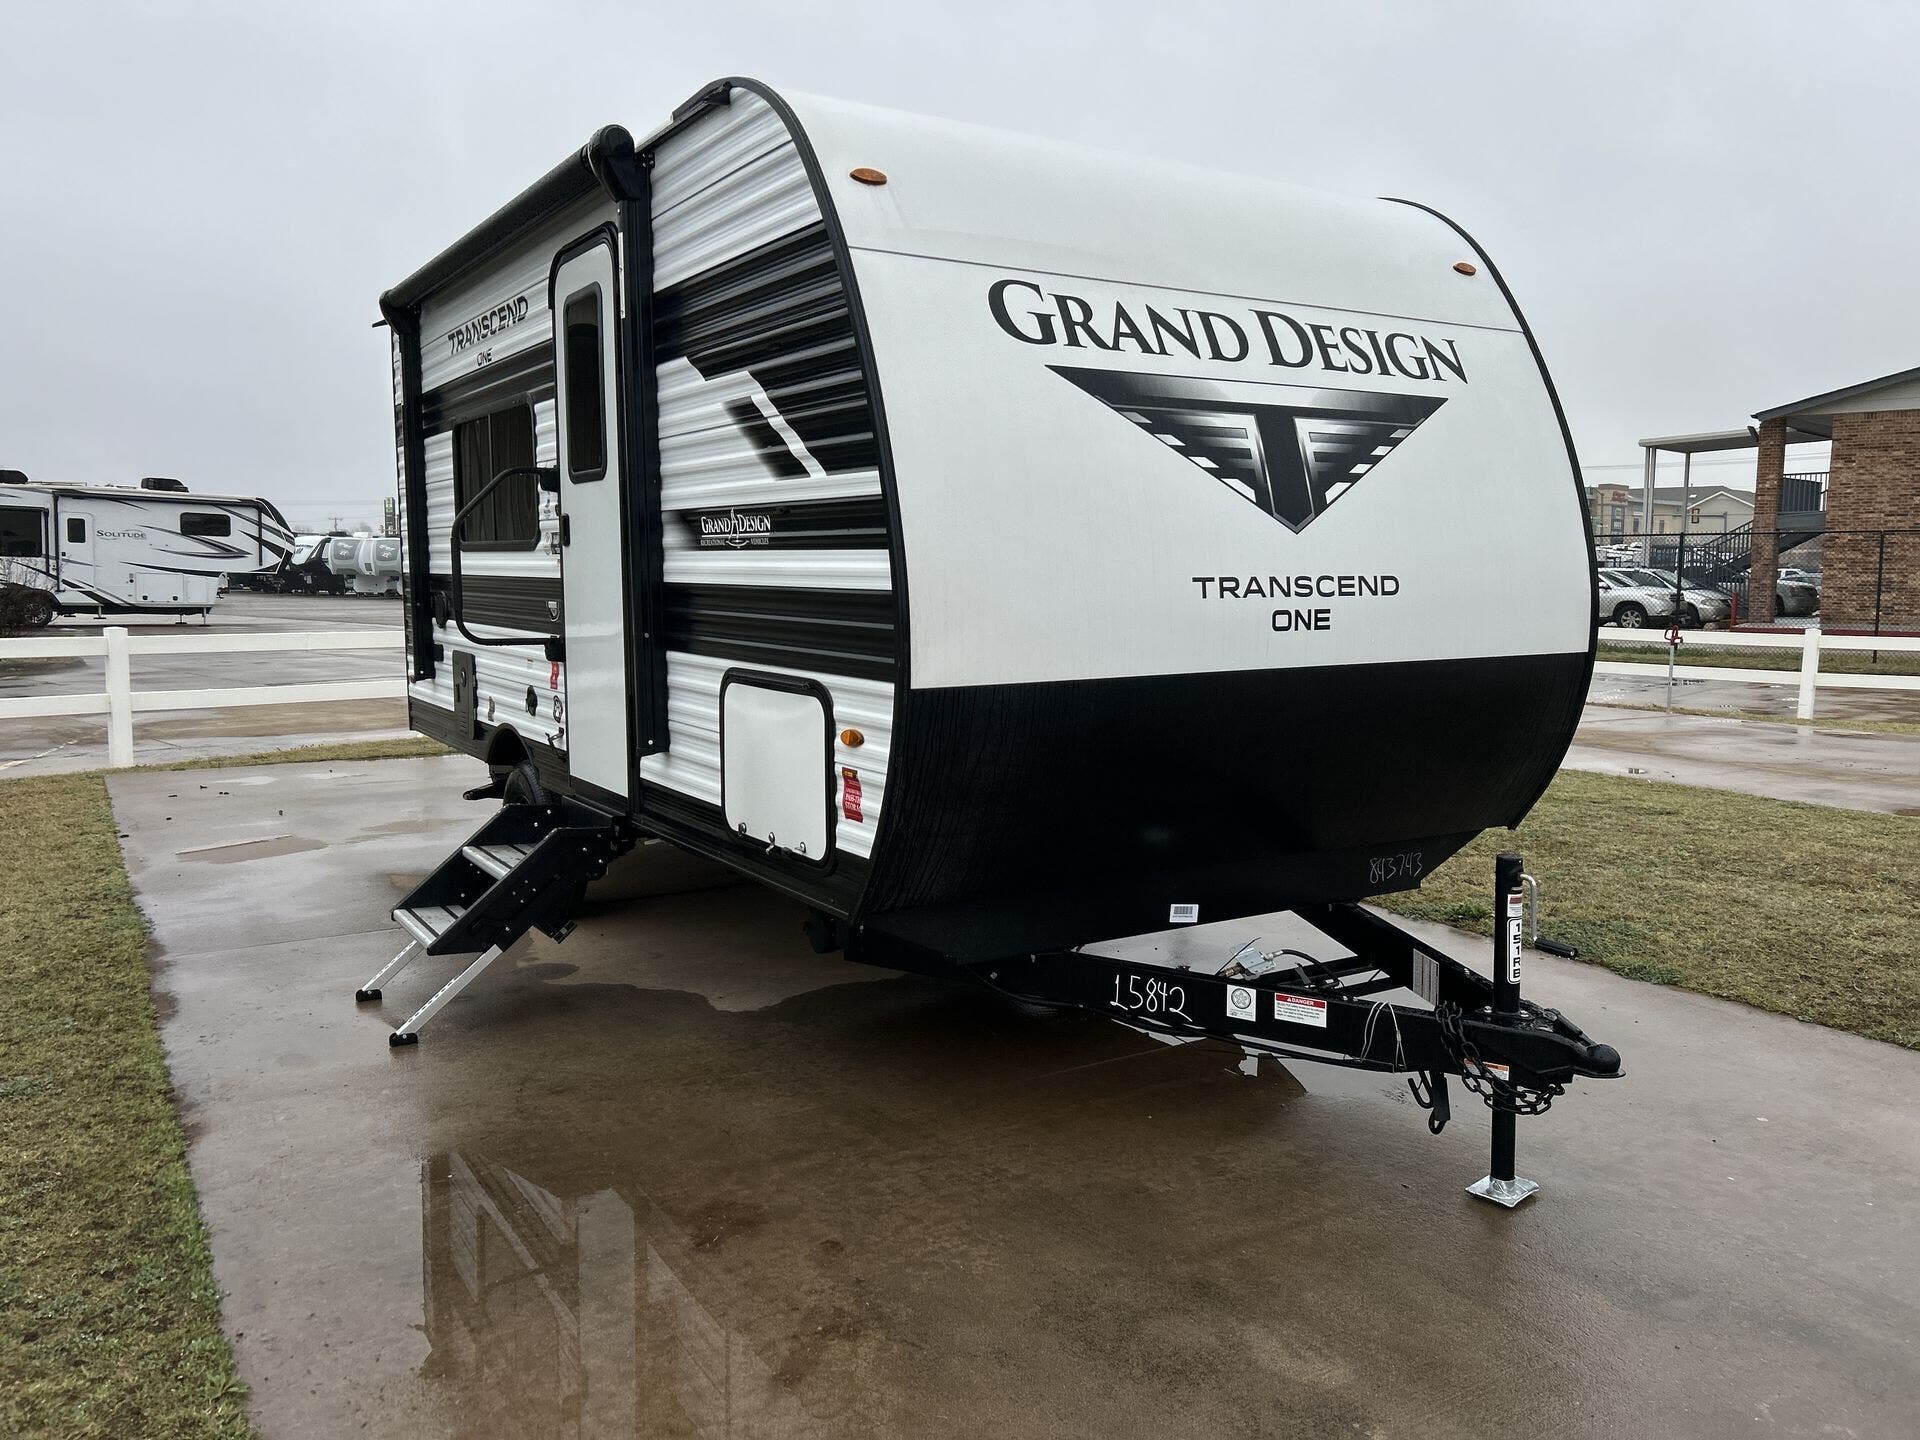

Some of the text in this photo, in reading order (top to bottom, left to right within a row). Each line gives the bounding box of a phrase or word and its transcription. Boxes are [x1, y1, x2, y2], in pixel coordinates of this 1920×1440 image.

[448, 295, 528, 355] TRANSCEND
[987, 279, 1468, 385] GRAND DESIGN
[476, 347, 493, 367] ONE
[96, 529, 147, 539] SOLITUDE
[701, 514, 771, 533] GRAND DESIGN
[1191, 575, 1400, 599] TRANSCEND
[1271, 608, 1331, 632] ONE
[1369, 852, 1423, 884] 843743
[1291, 997, 1315, 1006] DANGER
